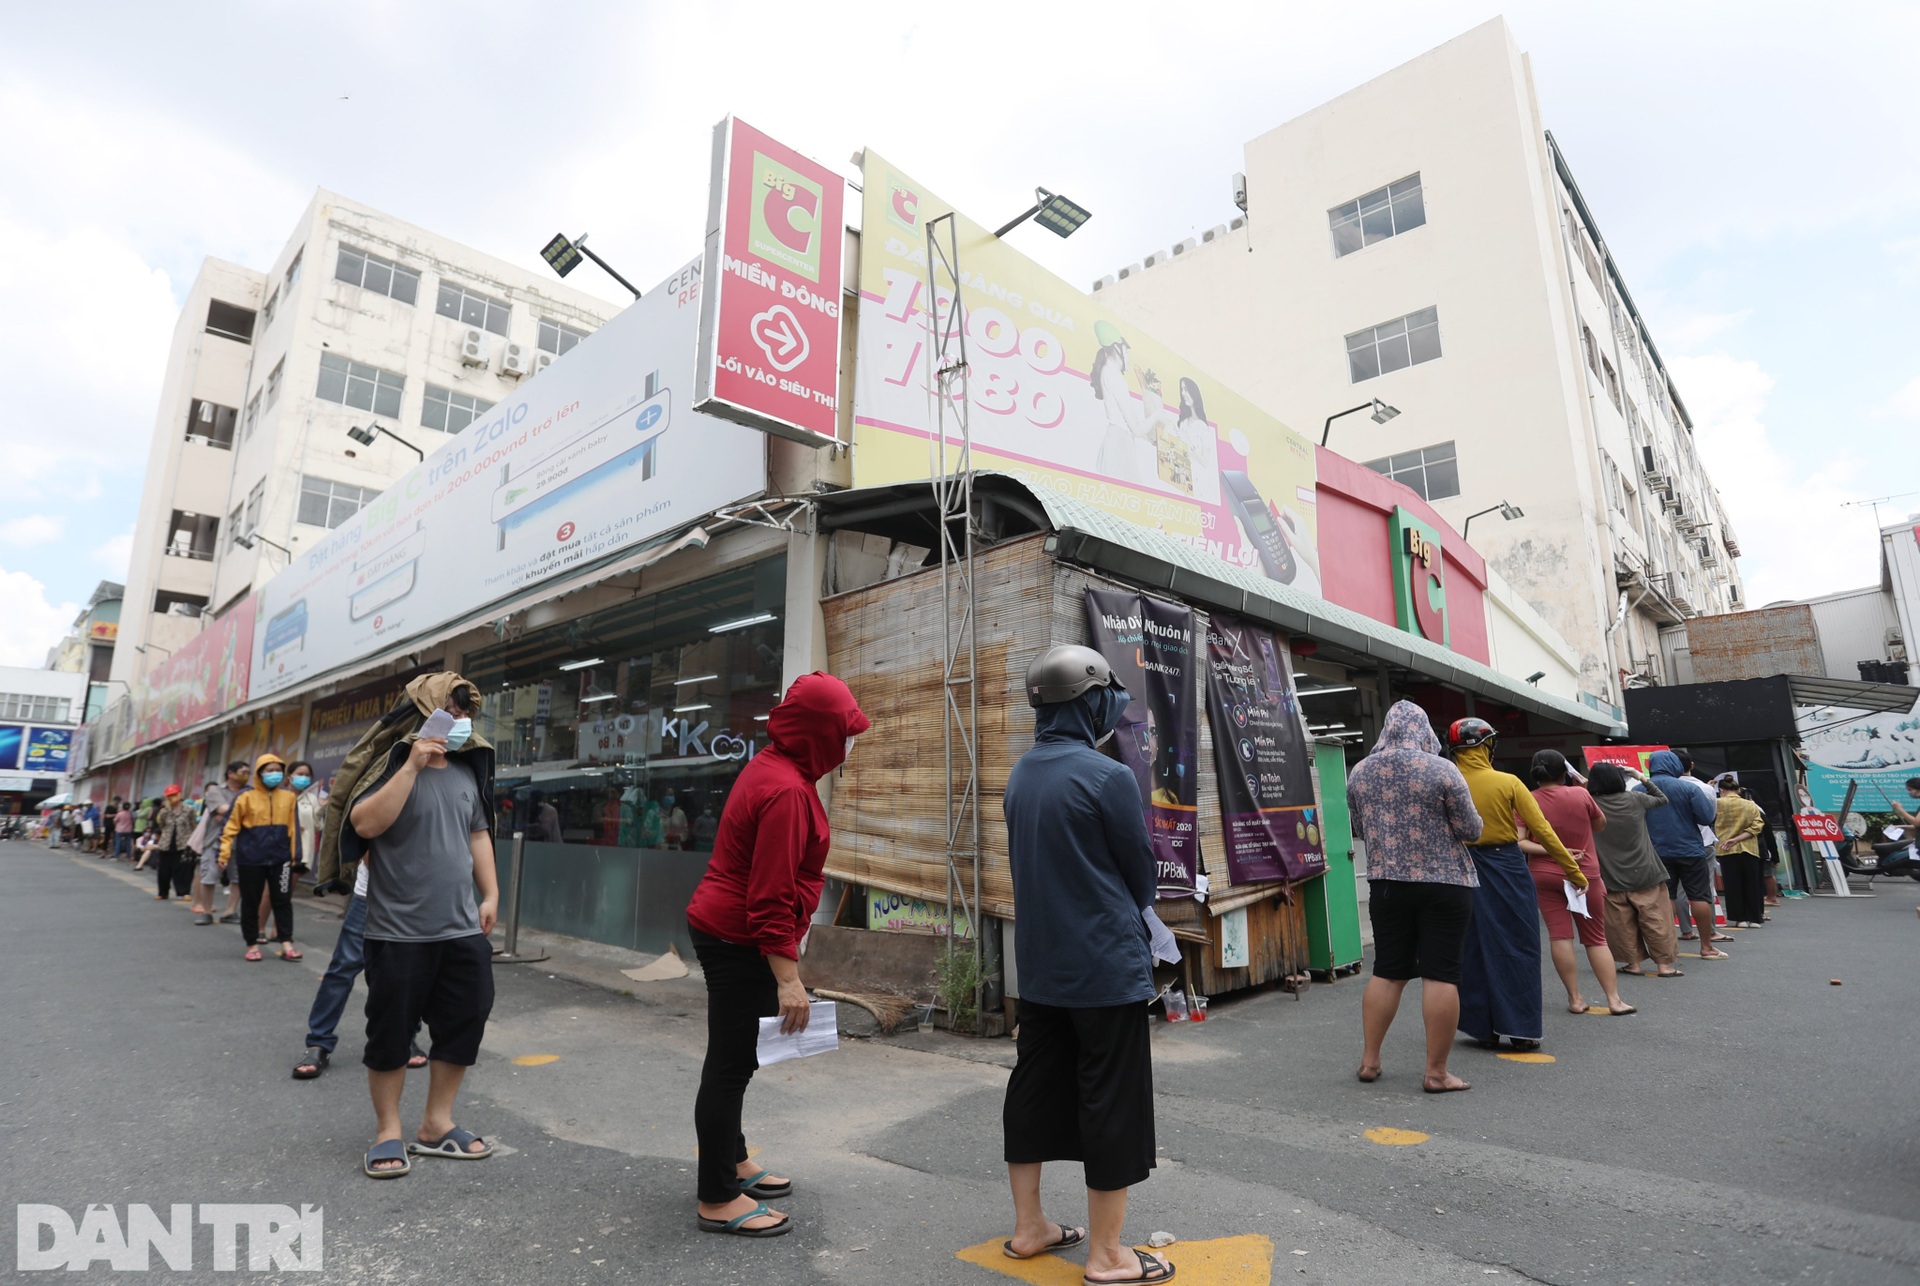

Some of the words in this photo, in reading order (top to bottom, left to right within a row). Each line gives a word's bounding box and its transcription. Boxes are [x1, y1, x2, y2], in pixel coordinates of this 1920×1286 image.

[762, 168, 797, 202] Big
[891, 181, 908, 199] Big
[763, 182, 819, 255] C
[892, 188, 918, 225] C
[754, 240, 816, 273] SUPERCENTER
[723, 253, 776, 294] MIỀN
[780, 281, 839, 319] ĐÔNG
[883, 266, 1066, 376] 1900
[1028, 299, 1075, 332] QUA
[717, 354, 742, 376] LỐI
[745, 363, 777, 388] VÀO
[779, 376, 811, 400] SIÊU
[812, 390, 836, 412] THỊ
[567, 446, 588, 463] xanh
[587, 433, 609, 451] baby
[1286, 436, 1309, 456] CENTRAL
[331, 524, 362, 557] hàng
[366, 494, 399, 529] Big
[406, 468, 423, 501] C
[428, 450, 467, 486] trên
[473, 402, 529, 455] Zalo
[359, 534, 382, 553] 10km
[446, 432, 529, 493] 200.000vnd
[531, 418, 553, 438] trở
[556, 400, 580, 422] lên
[535, 466, 570, 490] 29.900đ
[1008, 466, 1073, 496] GIAO
[1076, 482, 1142, 513] HÀNG
[1144, 500, 1183, 525] TẬN
[1185, 509, 1217, 530] NƠI
[484, 571, 505, 587] Tham
[506, 562, 527, 577] khảo
[527, 557, 538, 568] và
[538, 548, 556, 563] đặt
[557, 539, 582, 553] mua
[583, 530, 598, 544] tất
[598, 523, 612, 536] cả
[613, 515, 634, 531] sản
[635, 498, 672, 523] phẩm
[560, 524, 571, 539] 3
[1405, 527, 1431, 569] Big
[524, 559, 561, 580] khuyến
[562, 550, 584, 564] mãi
[584, 541, 605, 556] hấp
[606, 531, 629, 547] dẫn
[1226, 541, 1259, 569] LỢI
[1410, 541, 1445, 646] C
[1102, 613, 1127, 632] Nhận
[1127, 614, 1143, 629] Di
[1144, 618, 1181, 641] Khuôn
[1162, 643, 1178, 653] giao
[319, 697, 352, 729] PHIẾU
[353, 696, 381, 721] MUA
[1176, 822, 1193, 832] 2020
[1797, 818, 1809, 827] LỐI
[1809, 818, 1823, 827] VÀO
[1156, 861, 1189, 879] TPBank
[1303, 853, 1322, 863] TPBank
[279, 866, 291, 893] adidas
